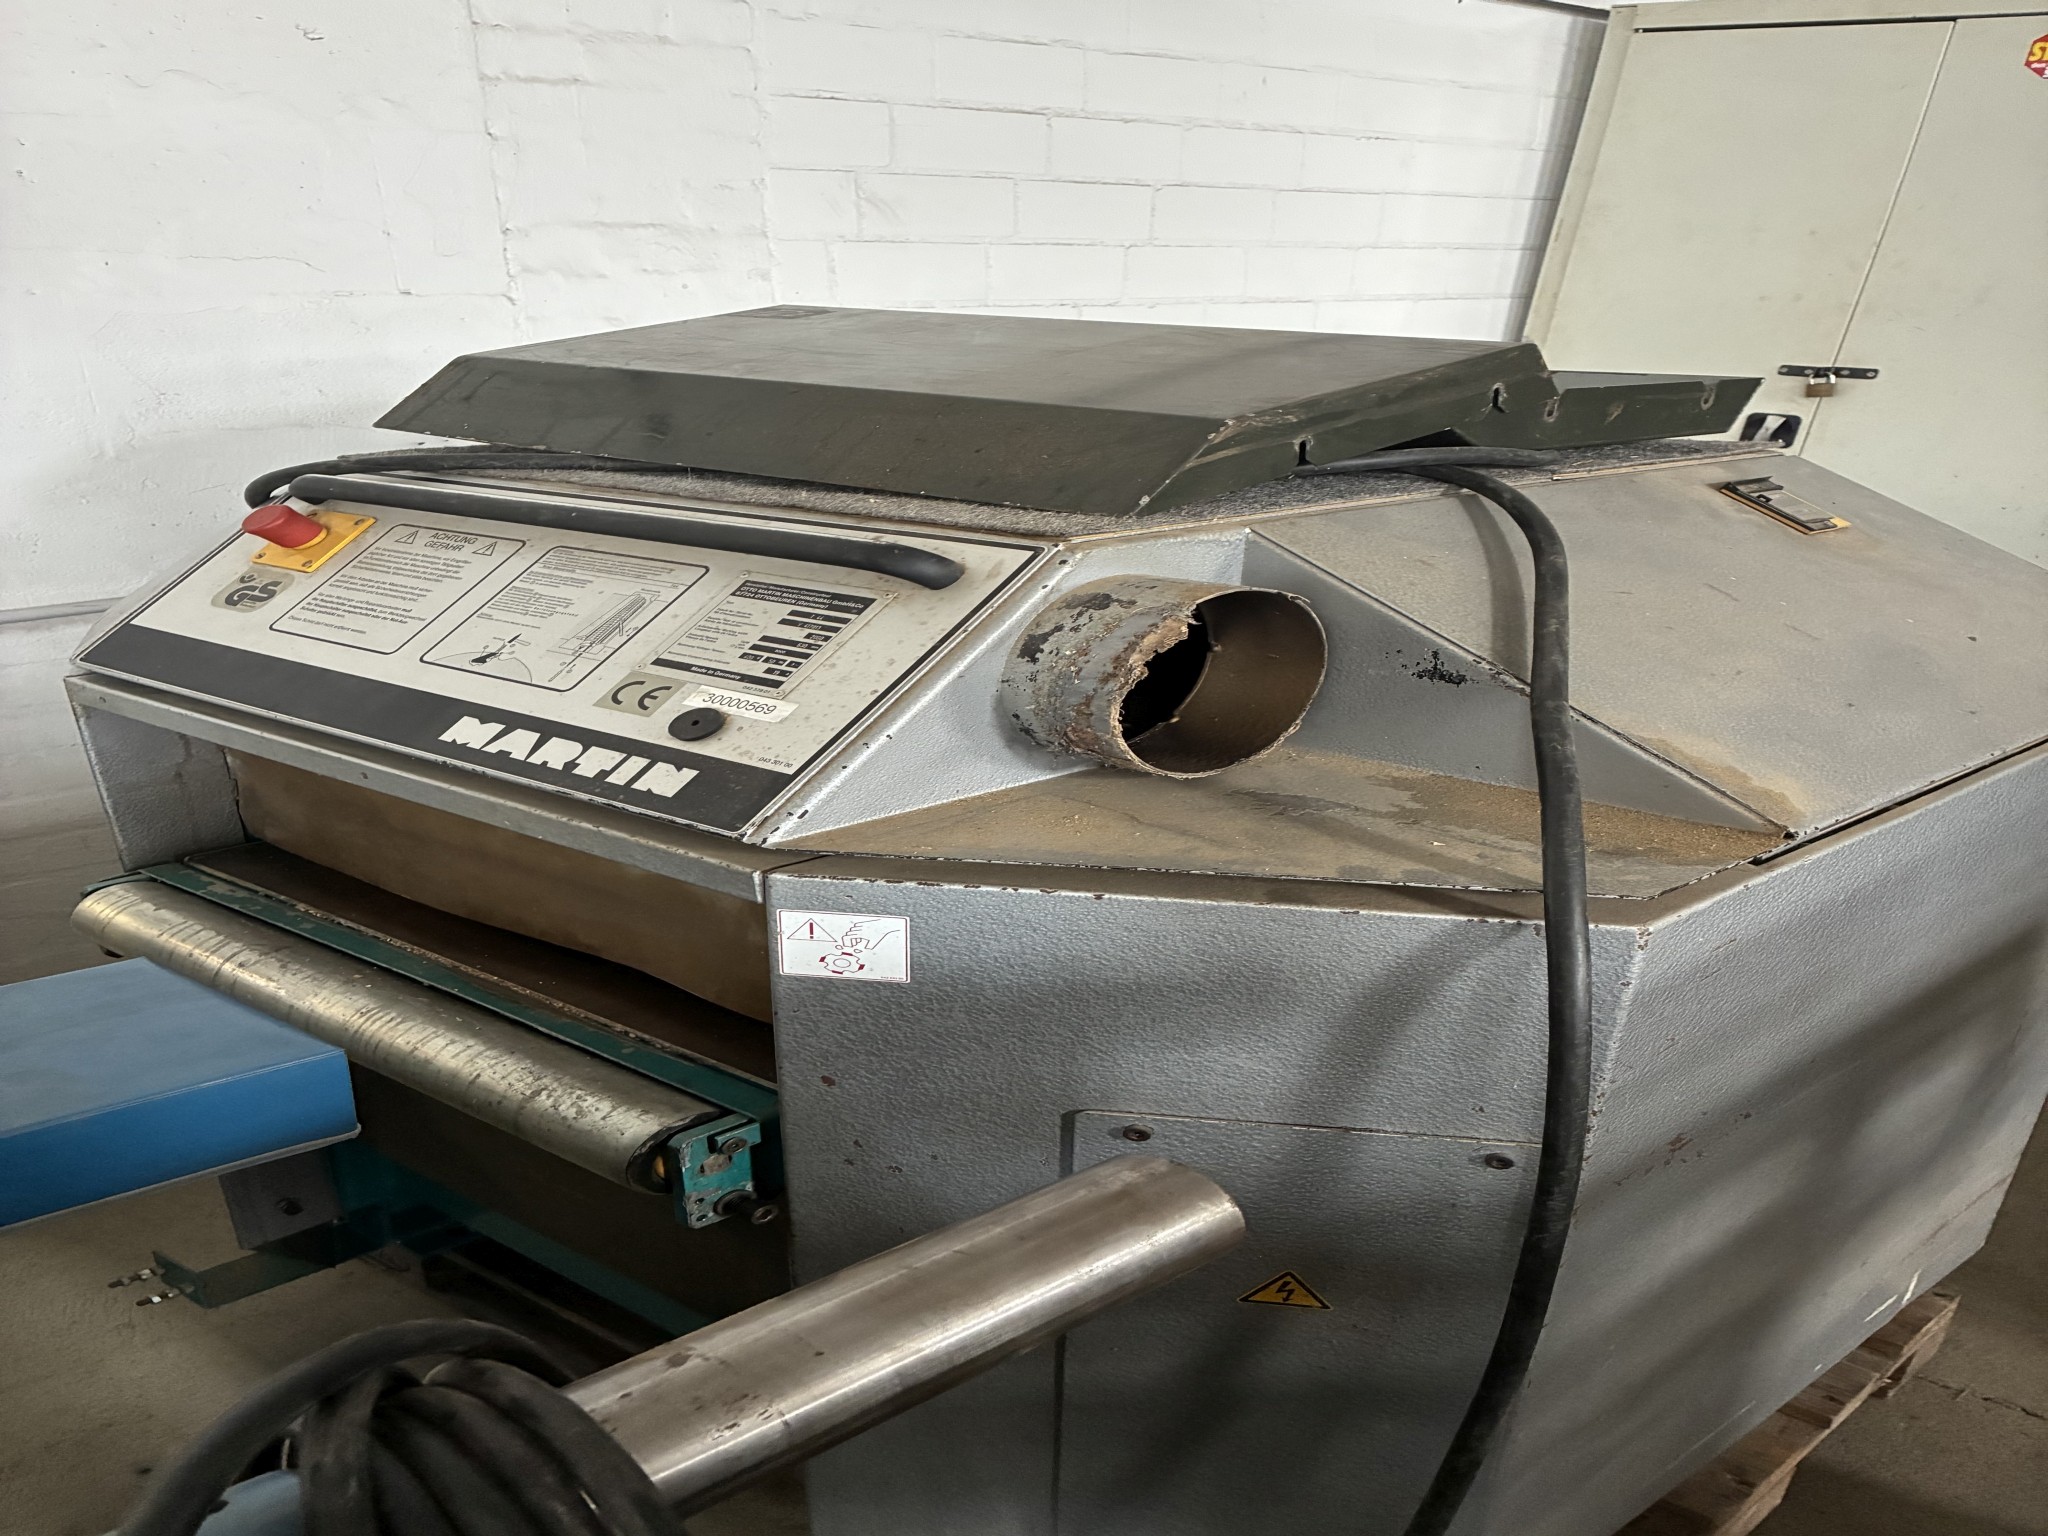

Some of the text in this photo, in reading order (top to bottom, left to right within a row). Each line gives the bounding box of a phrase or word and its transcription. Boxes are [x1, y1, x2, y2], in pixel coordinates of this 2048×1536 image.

[428, 532, 479, 545] ACHTUNG
[424, 540, 465, 552] GEFAHR
[740, 586, 759, 594] OTTO
[758, 588, 781, 596] MARTIN
[714, 671, 742, 680] Germany
[611, 680, 673, 711] CE
[702, 692, 777, 714] 30000569
[437, 715, 700, 798] MARTIN
